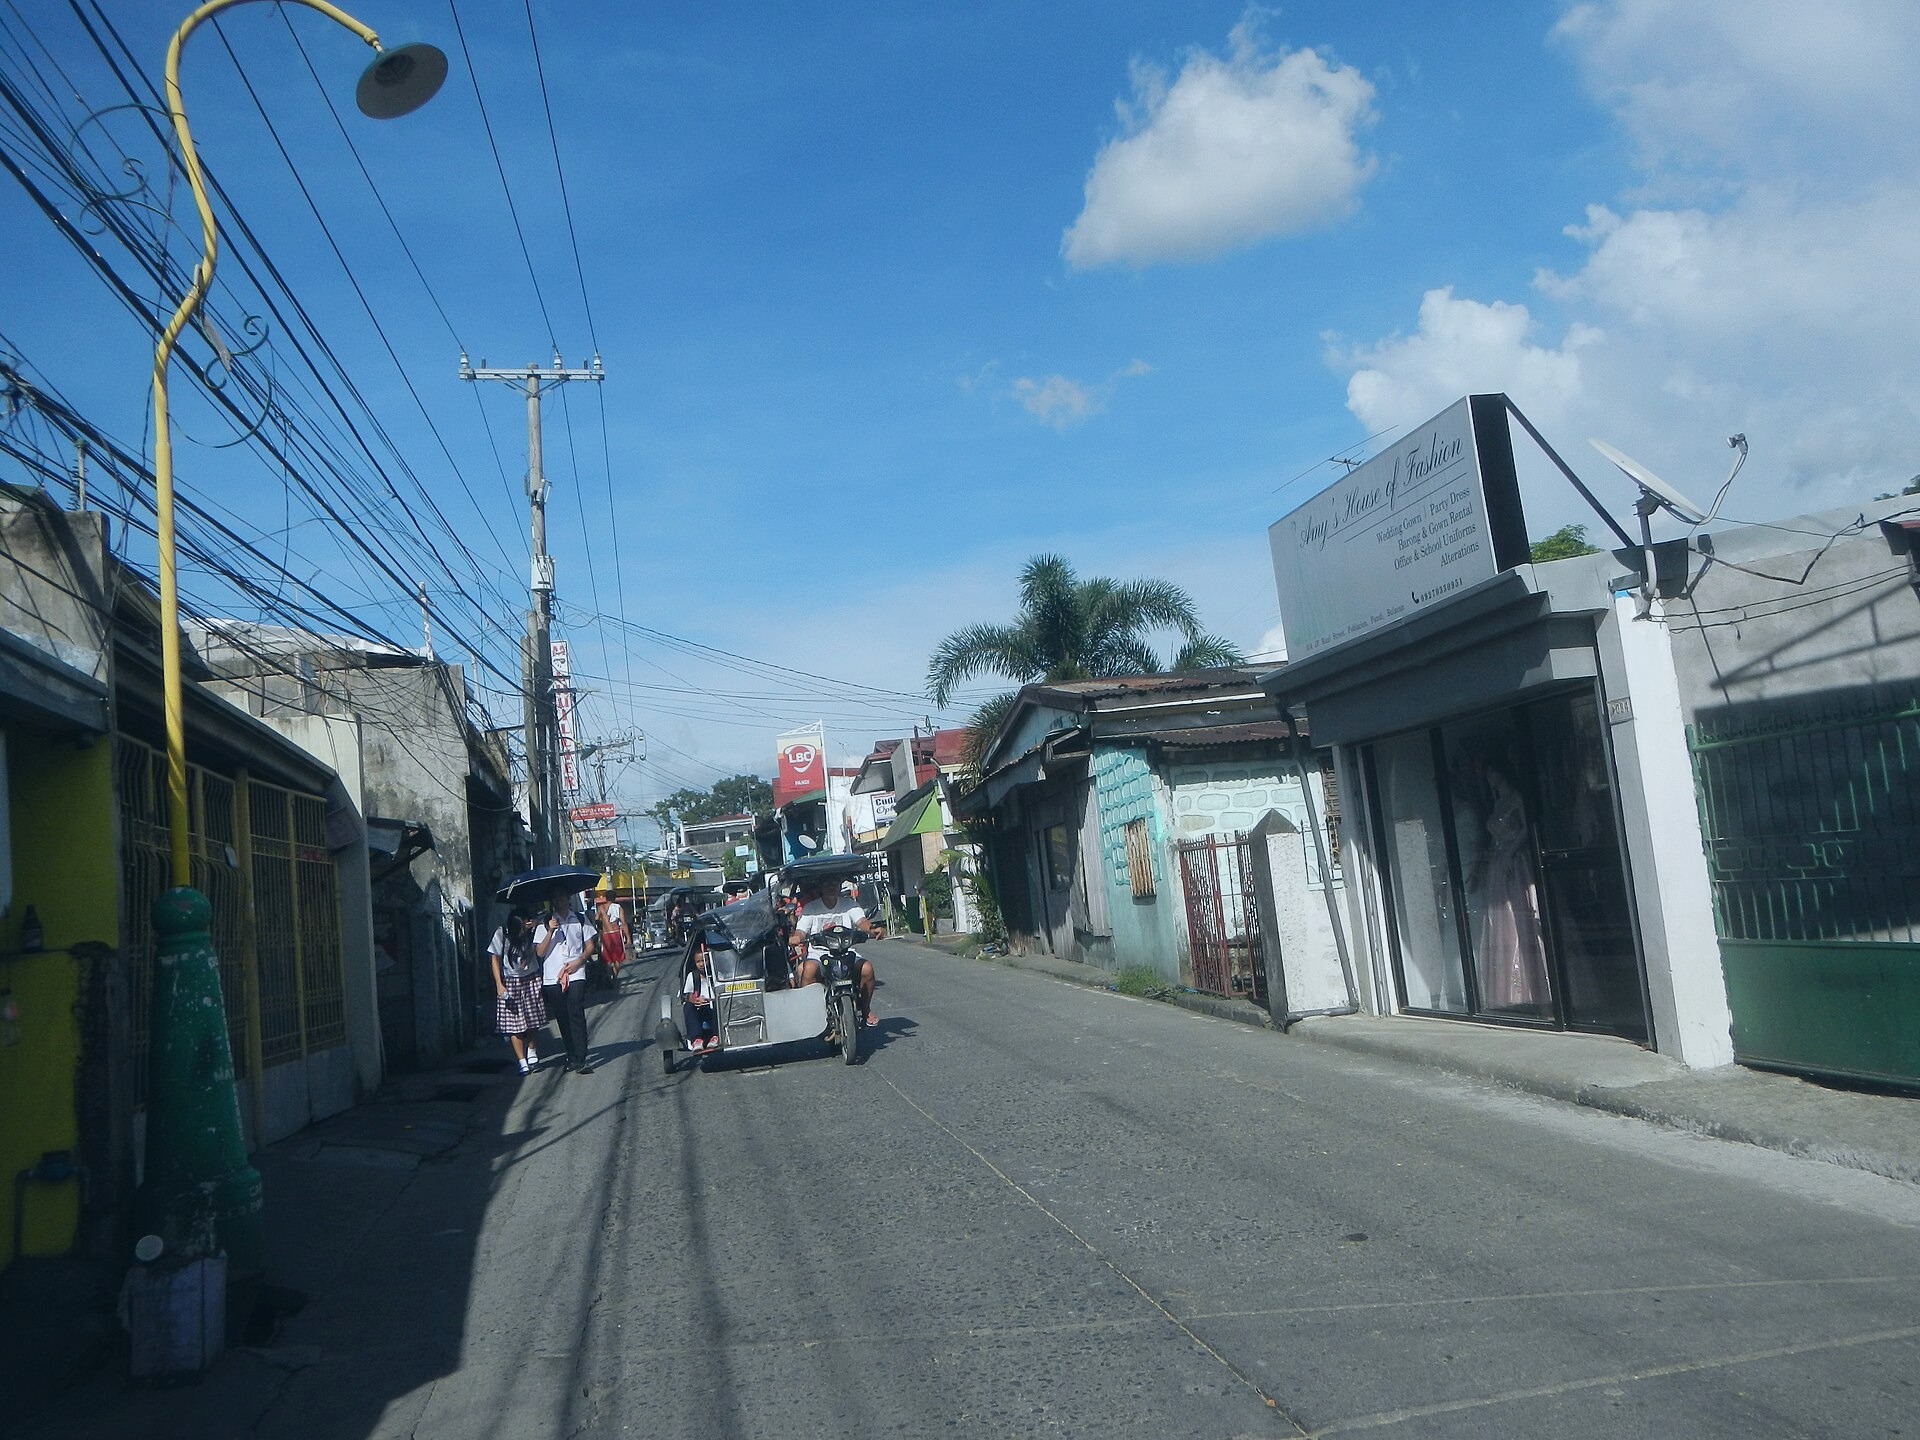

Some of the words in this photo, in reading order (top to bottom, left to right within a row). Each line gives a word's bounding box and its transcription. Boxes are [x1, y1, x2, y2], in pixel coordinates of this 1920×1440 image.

[1343, 486, 1380, 523] House
[1386, 457, 1400, 511] of
[1403, 432, 1463, 486] Fashion
[1376, 524, 1403, 543] Wedding
[1403, 515, 1422, 530] Gown
[1430, 499, 1448, 516] Party
[1449, 488, 1470, 504] Dress
[1398, 534, 1421, 551] Barong
[1422, 527, 1428, 538] &
[1428, 518, 1449, 535] Gown
[1450, 502, 1473, 524] Rental
[1394, 556, 1413, 570] Office
[1414, 549, 1420, 561] &
[1420, 539, 1442, 558] School
[1443, 523, 1477, 546] Uniforms
[1441, 541, 1480, 567] Alterations
[788, 751, 812, 763] LBC
